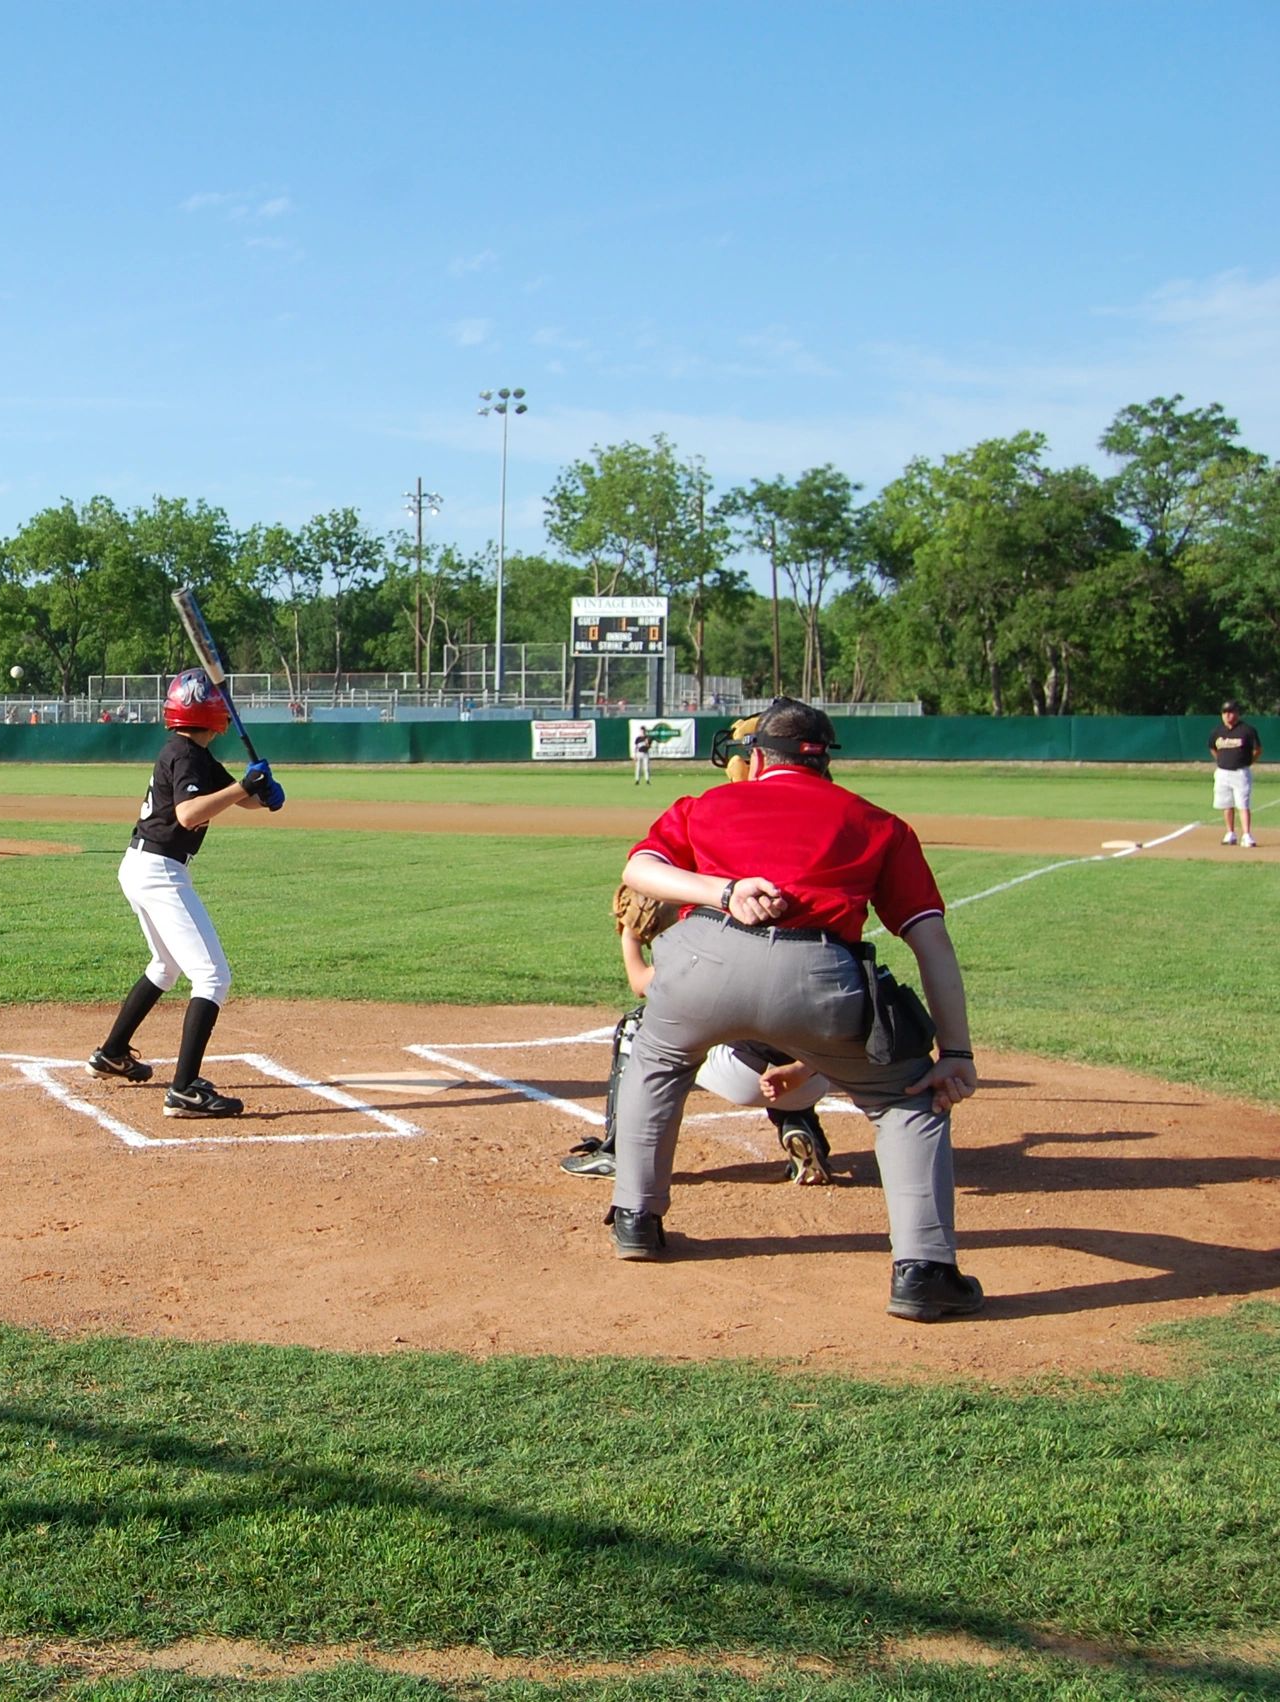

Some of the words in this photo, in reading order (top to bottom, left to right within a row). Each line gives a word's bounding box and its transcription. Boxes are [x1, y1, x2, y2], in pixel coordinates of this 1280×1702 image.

[575, 598, 627, 609] VINTAGE
[631, 598, 664, 609] BANK
[577, 617, 600, 626] GUEST
[637, 617, 661, 626] HOME
[588, 626, 598, 641] 0
[649, 626, 659, 641] 0
[575, 641, 592, 651] BALL
[598, 641, 623, 651] STRIKE
[628, 641, 644, 651] OUT
